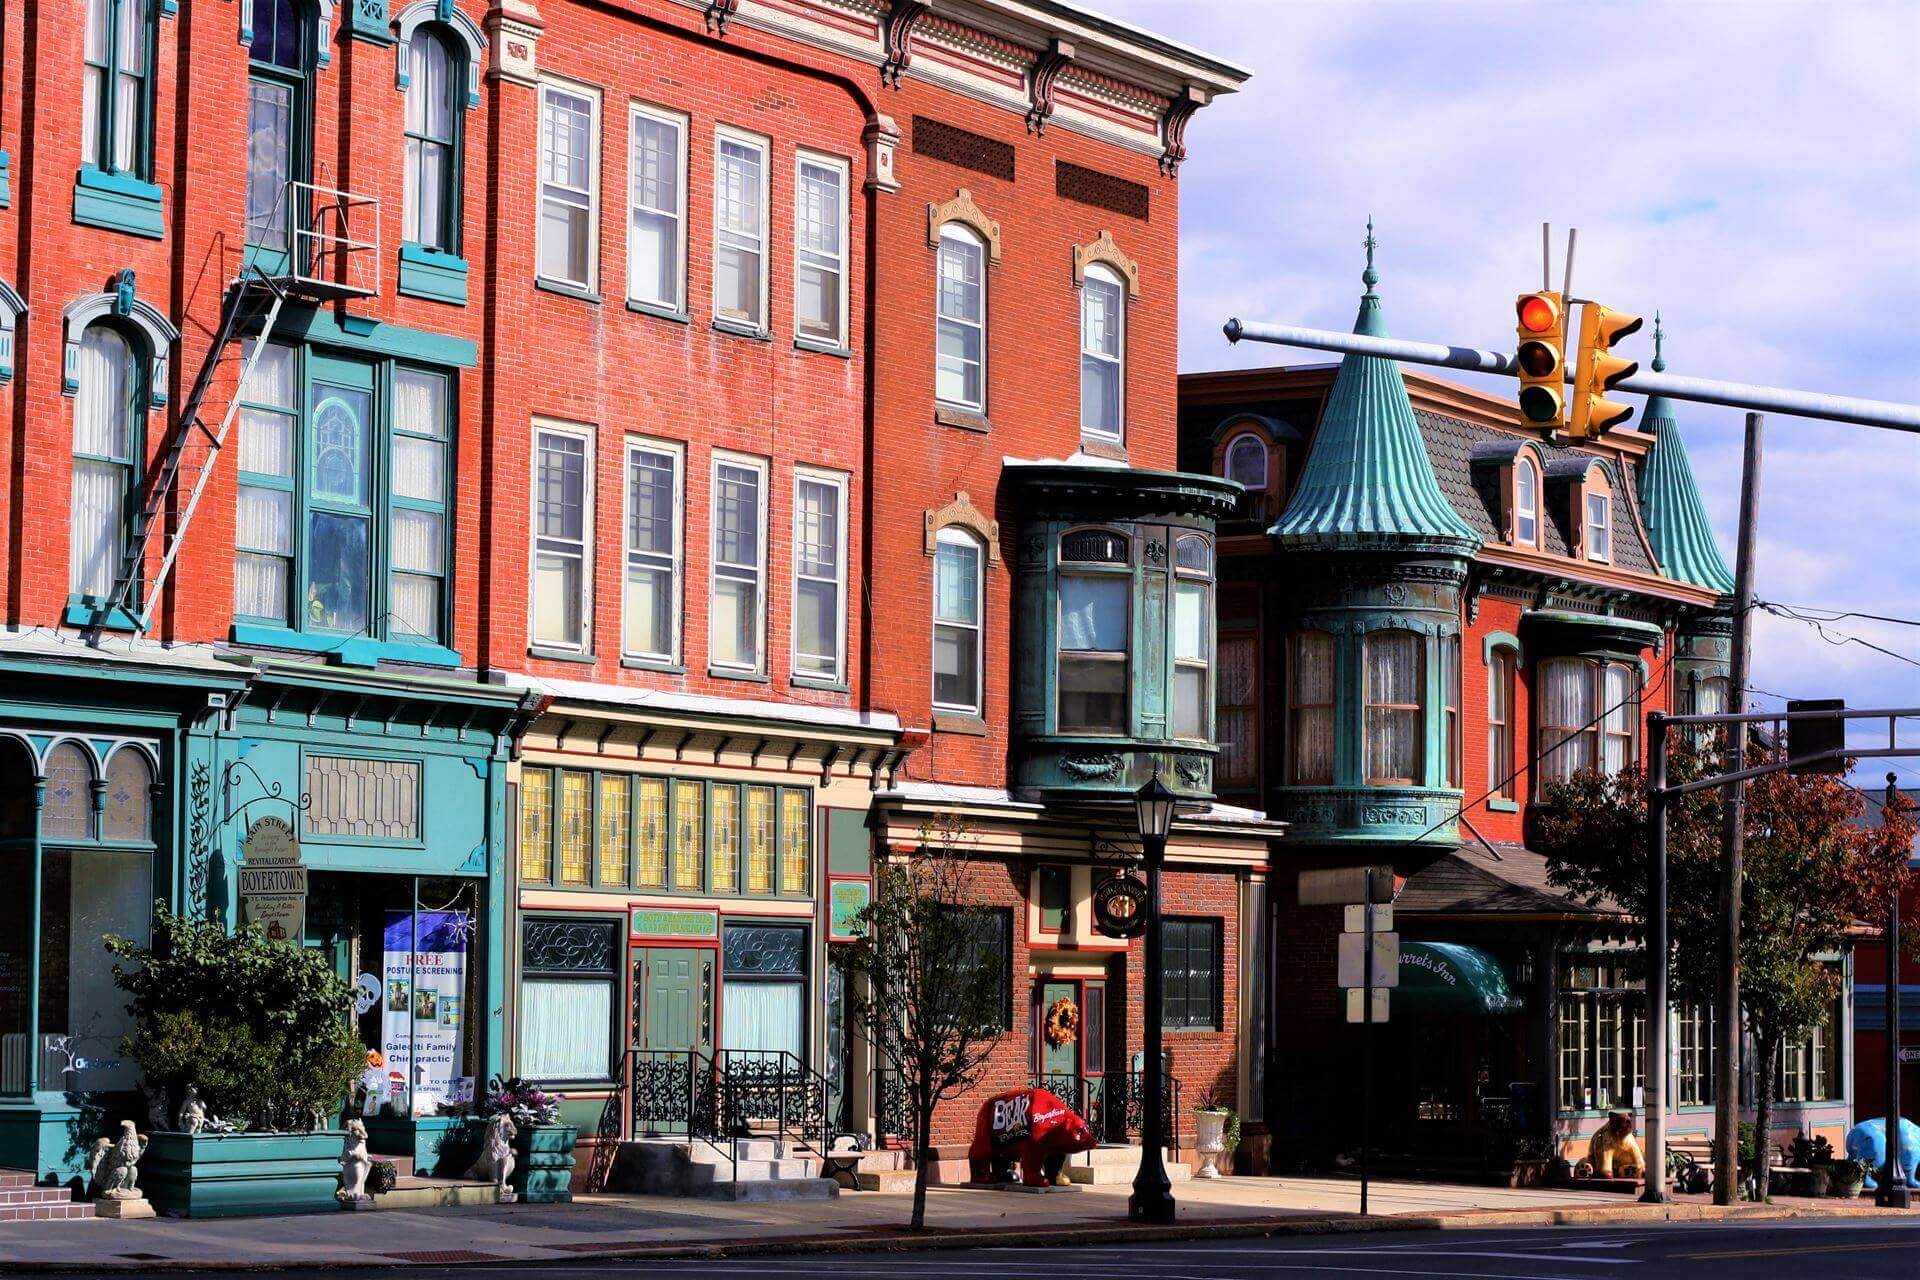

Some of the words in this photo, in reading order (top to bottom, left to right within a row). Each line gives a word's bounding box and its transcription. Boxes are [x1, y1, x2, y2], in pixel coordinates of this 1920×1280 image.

[246, 823, 262, 845] MAIN
[264, 818, 296, 842] STREET
[248, 857, 296, 865] REVITALIZATION
[241, 870, 304, 891] BOYERTOWN
[406, 955, 443, 966] FREE
[422, 967, 463, 975] SCREENING
[1398, 953, 1432, 969] urrets
[1433, 962, 1456, 985] Inn
[426, 1043, 456, 1052] Family
[389, 1055, 451, 1063] Chirpractic
[993, 1095, 1030, 1131] BEAR
